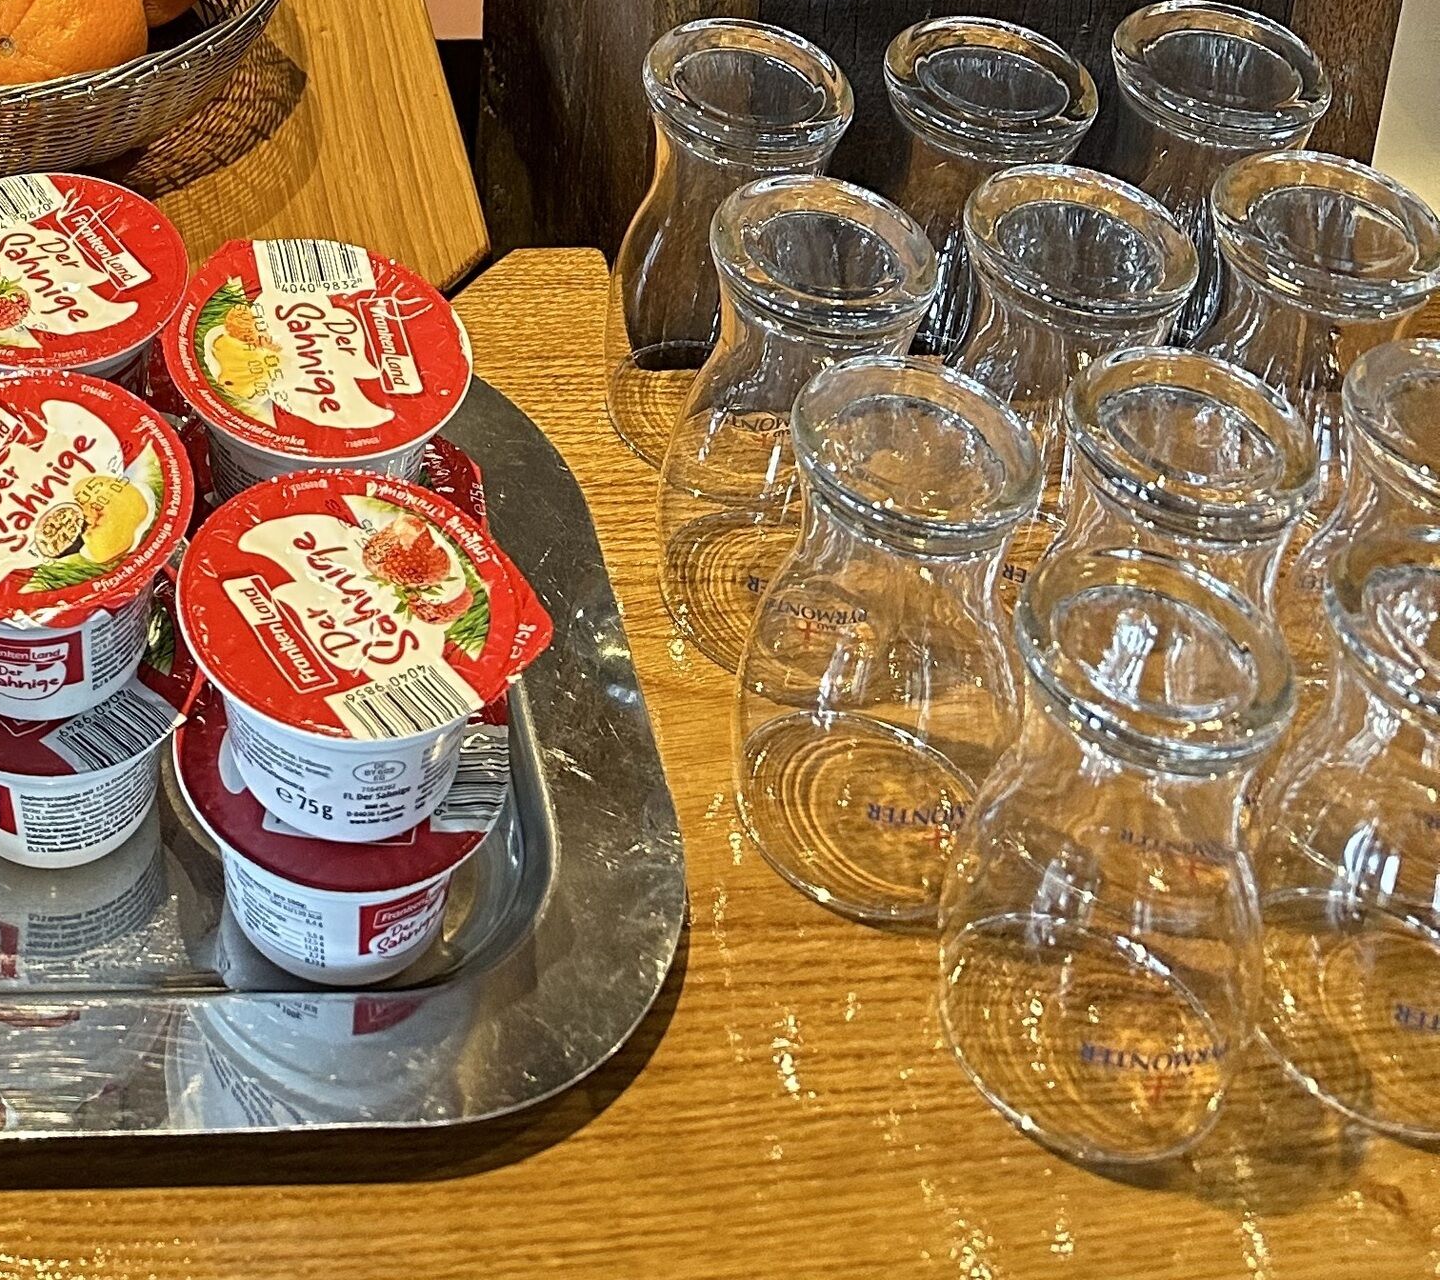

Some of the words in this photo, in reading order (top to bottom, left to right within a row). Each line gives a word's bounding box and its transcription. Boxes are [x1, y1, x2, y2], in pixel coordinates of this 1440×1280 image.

[36, 237, 80, 269] Der
[281, 282, 316, 294] 4040
[323, 280, 358, 292] 9832
[326, 318, 357, 357] Der
[275, 302, 341, 414] Sahnige
[293, 531, 419, 665] Sahnige
[307, 607, 360, 658] Der
[346, 684, 390, 703] 9856
[389, 665, 426, 687] 4040
